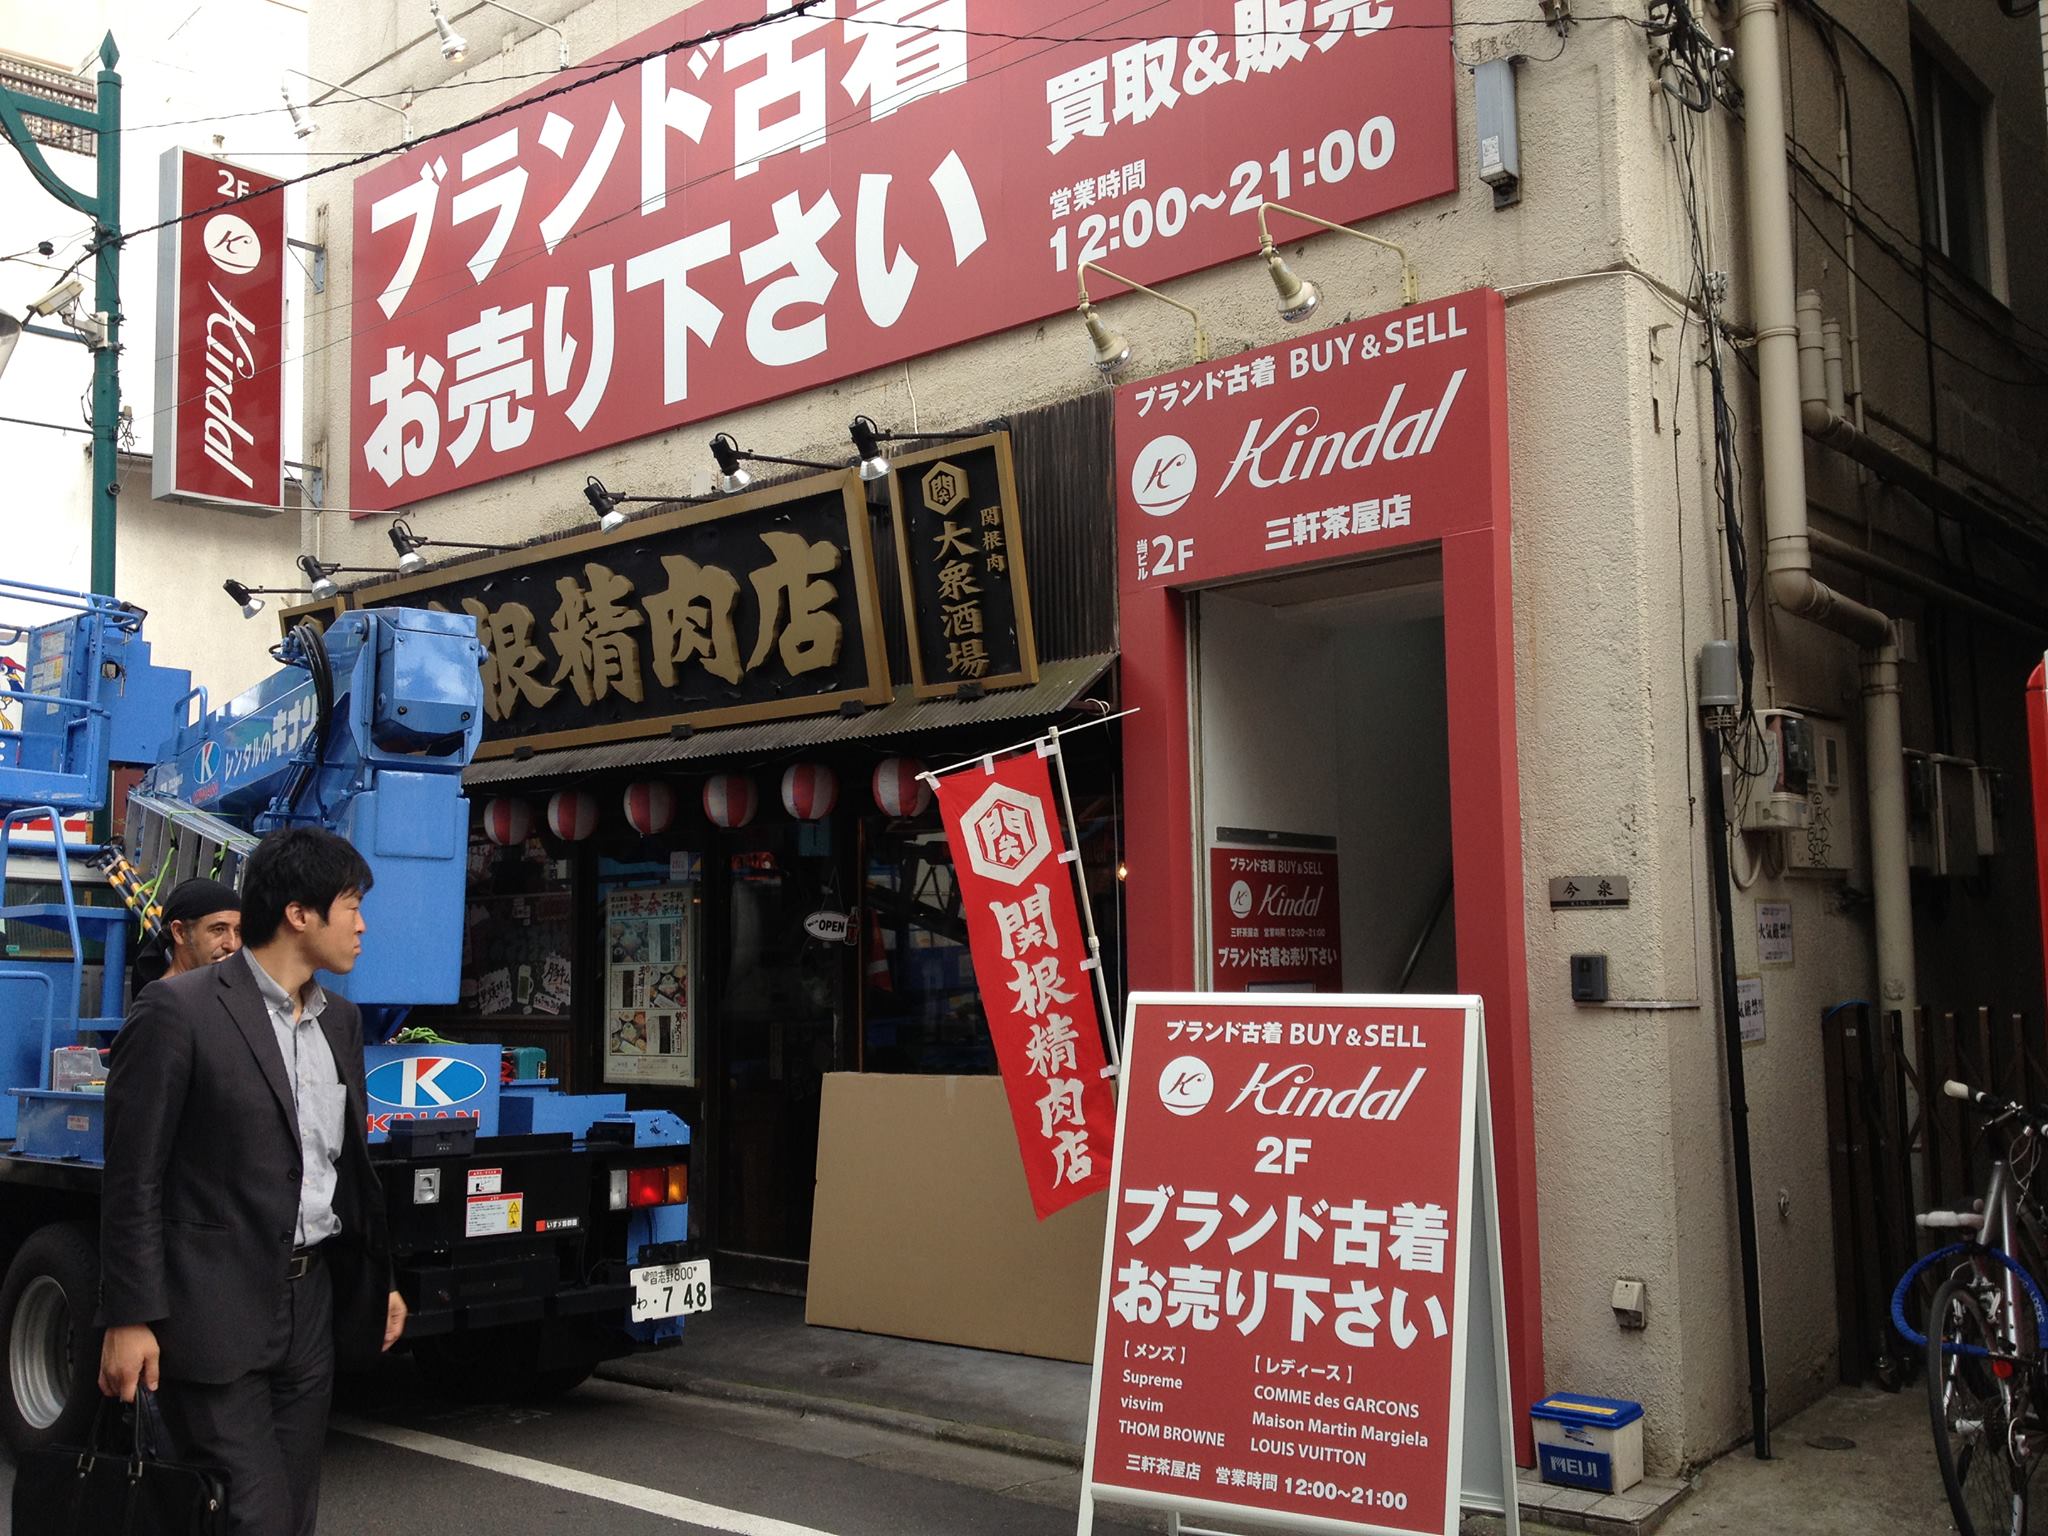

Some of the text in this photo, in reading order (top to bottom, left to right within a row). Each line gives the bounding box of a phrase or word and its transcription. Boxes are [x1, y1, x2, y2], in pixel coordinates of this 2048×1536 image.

[372, 0, 967, 320] ブランド古着
[217, 169, 250, 198] 2F
[1049, 159, 1146, 219] 営業時間
[364, 149, 988, 487] お売り下さい
[204, 281, 256, 488] Kindal
[1135, 355, 1276, 417] ブランド古着
[1215, 368, 1467, 498] Kindal
[979, 505, 1007, 573] 関根肉
[1265, 494, 1412, 551] 三軒茶屋店
[1136, 534, 1194, 580] 当ビル 2F
[932, 520, 991, 678] 大衆酒場
[440, 531, 842, 721] 根精肉店
[1230, 857, 1276, 873] ブランド古着
[1257, 883, 1324, 917] Kindal
[1564, 879, 1614, 898] 今泉
[818, 919, 846, 933] OPEN
[1218, 946, 1338, 968] ブランド古着お売り下さい
[988, 883, 1092, 1190] 関根精肉店
[1166, 1020, 1283, 1044] ブランド古着
[1225, 1062, 1427, 1120] Kindal
[1254, 1136, 1312, 1174] 2F
[1124, 1184, 1449, 1273] ブランド古着
[1112, 1258, 1449, 1349] お売り下さい
[1122, 1370, 1183, 1390] Supreme
[1120, 1396, 1164, 1413] visvim
[1254, 1385, 1420, 1418] COMME des GARCONS
[1119, 1420, 1226, 1447] THOM BROWNE
[1252, 1412, 1429, 1449] Maison Martin Margiela
[1250, 1438, 1367, 1467] LOUIS VUITTON
[1550, 1455, 1599, 1478] MEIJI
[1125, 1454, 1202, 1481] 三軒茶屋店
[1215, 1466, 1278, 1492] 営業時間
